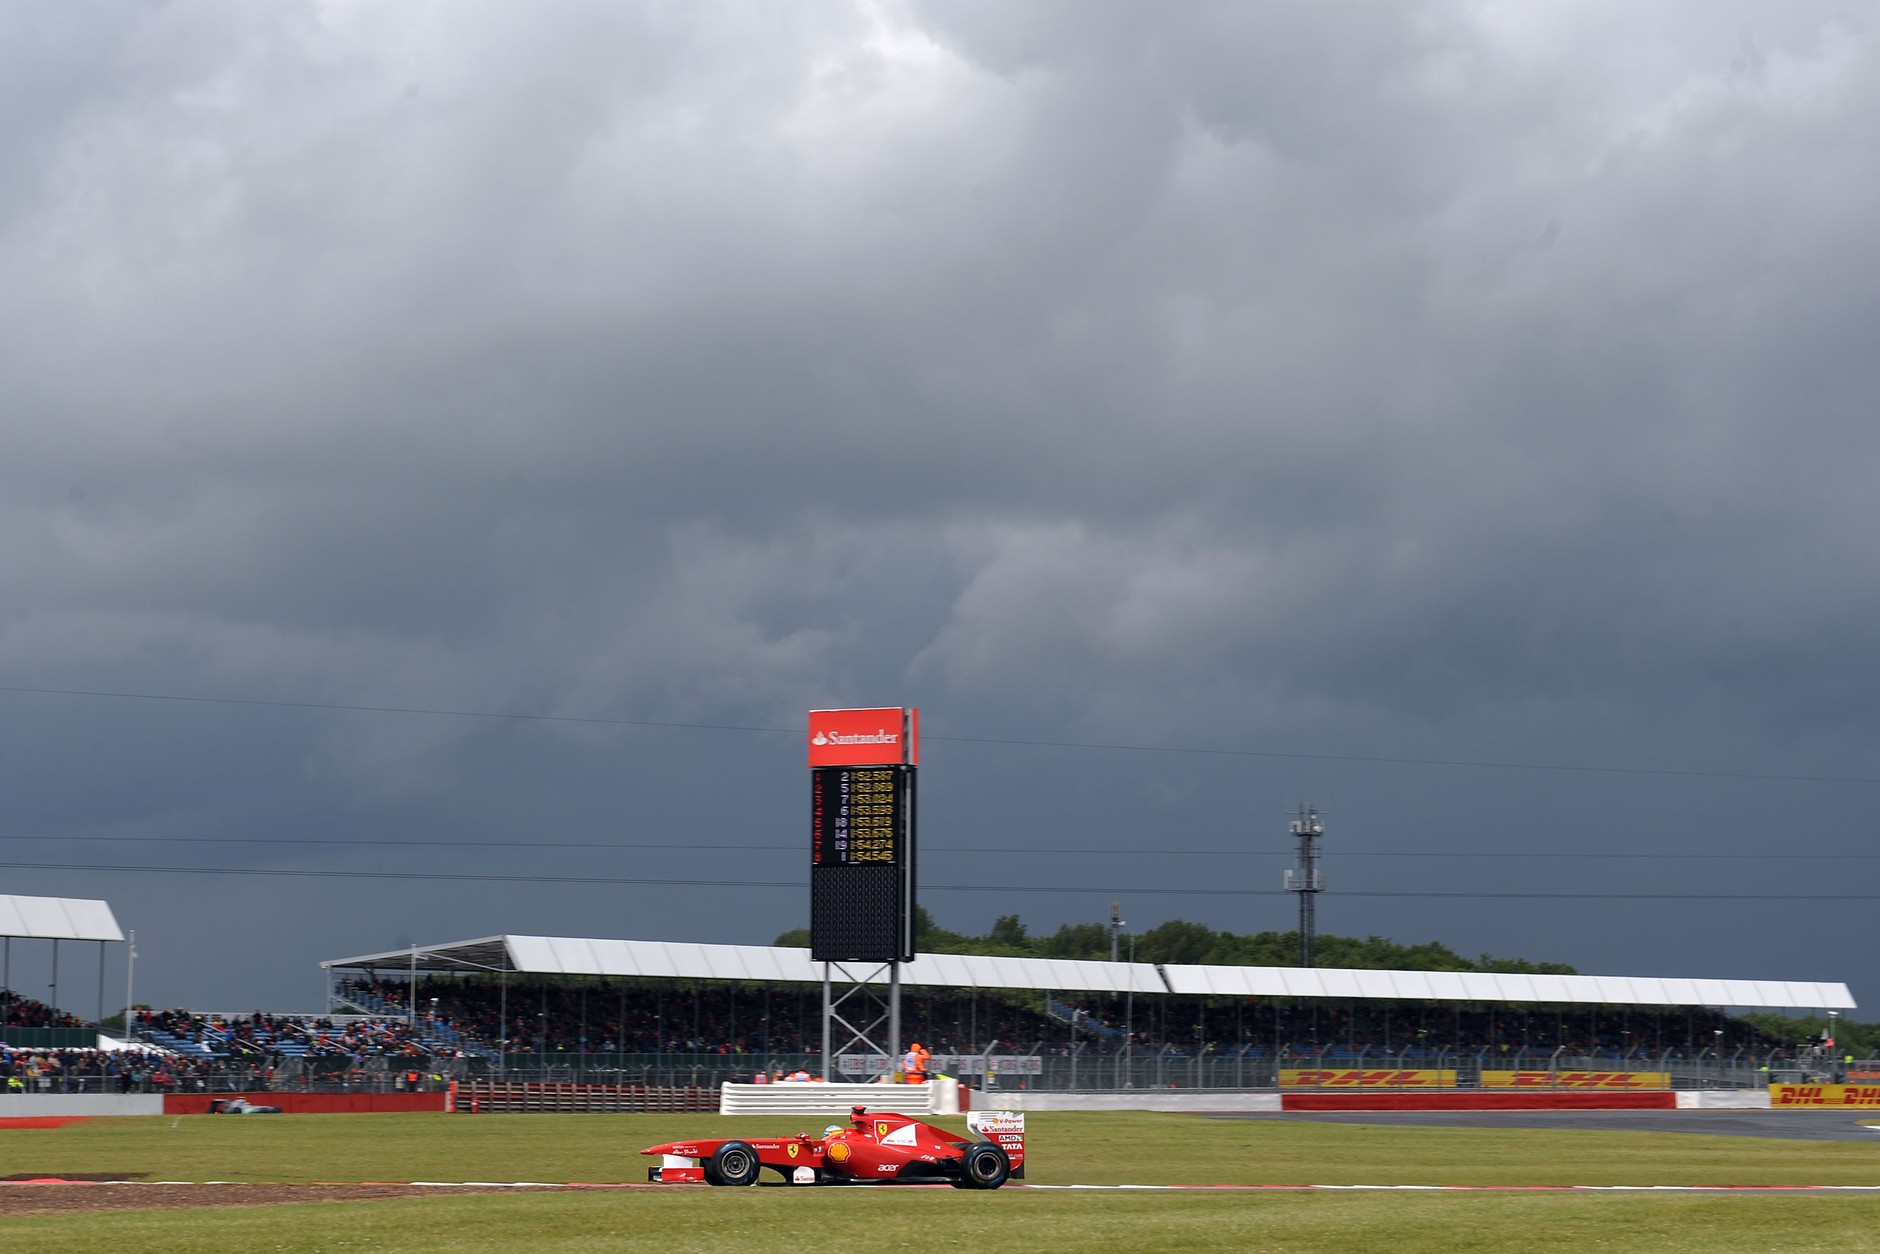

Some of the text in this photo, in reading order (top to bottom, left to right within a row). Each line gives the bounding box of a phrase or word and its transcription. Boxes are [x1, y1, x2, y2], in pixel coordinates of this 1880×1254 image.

[828, 729, 898, 745] Santander
[841, 771, 849, 781] 2
[841, 783, 849, 793] 5
[841, 794, 849, 804] 7
[841, 806, 849, 815] 6
[814, 817, 822, 827] 5
[1296, 1071, 1426, 1085] DHL
[1510, 1072, 1643, 1087] DHL
[1780, 1087, 1826, 1104] DHL
[1842, 1087, 1880, 1104] DH
